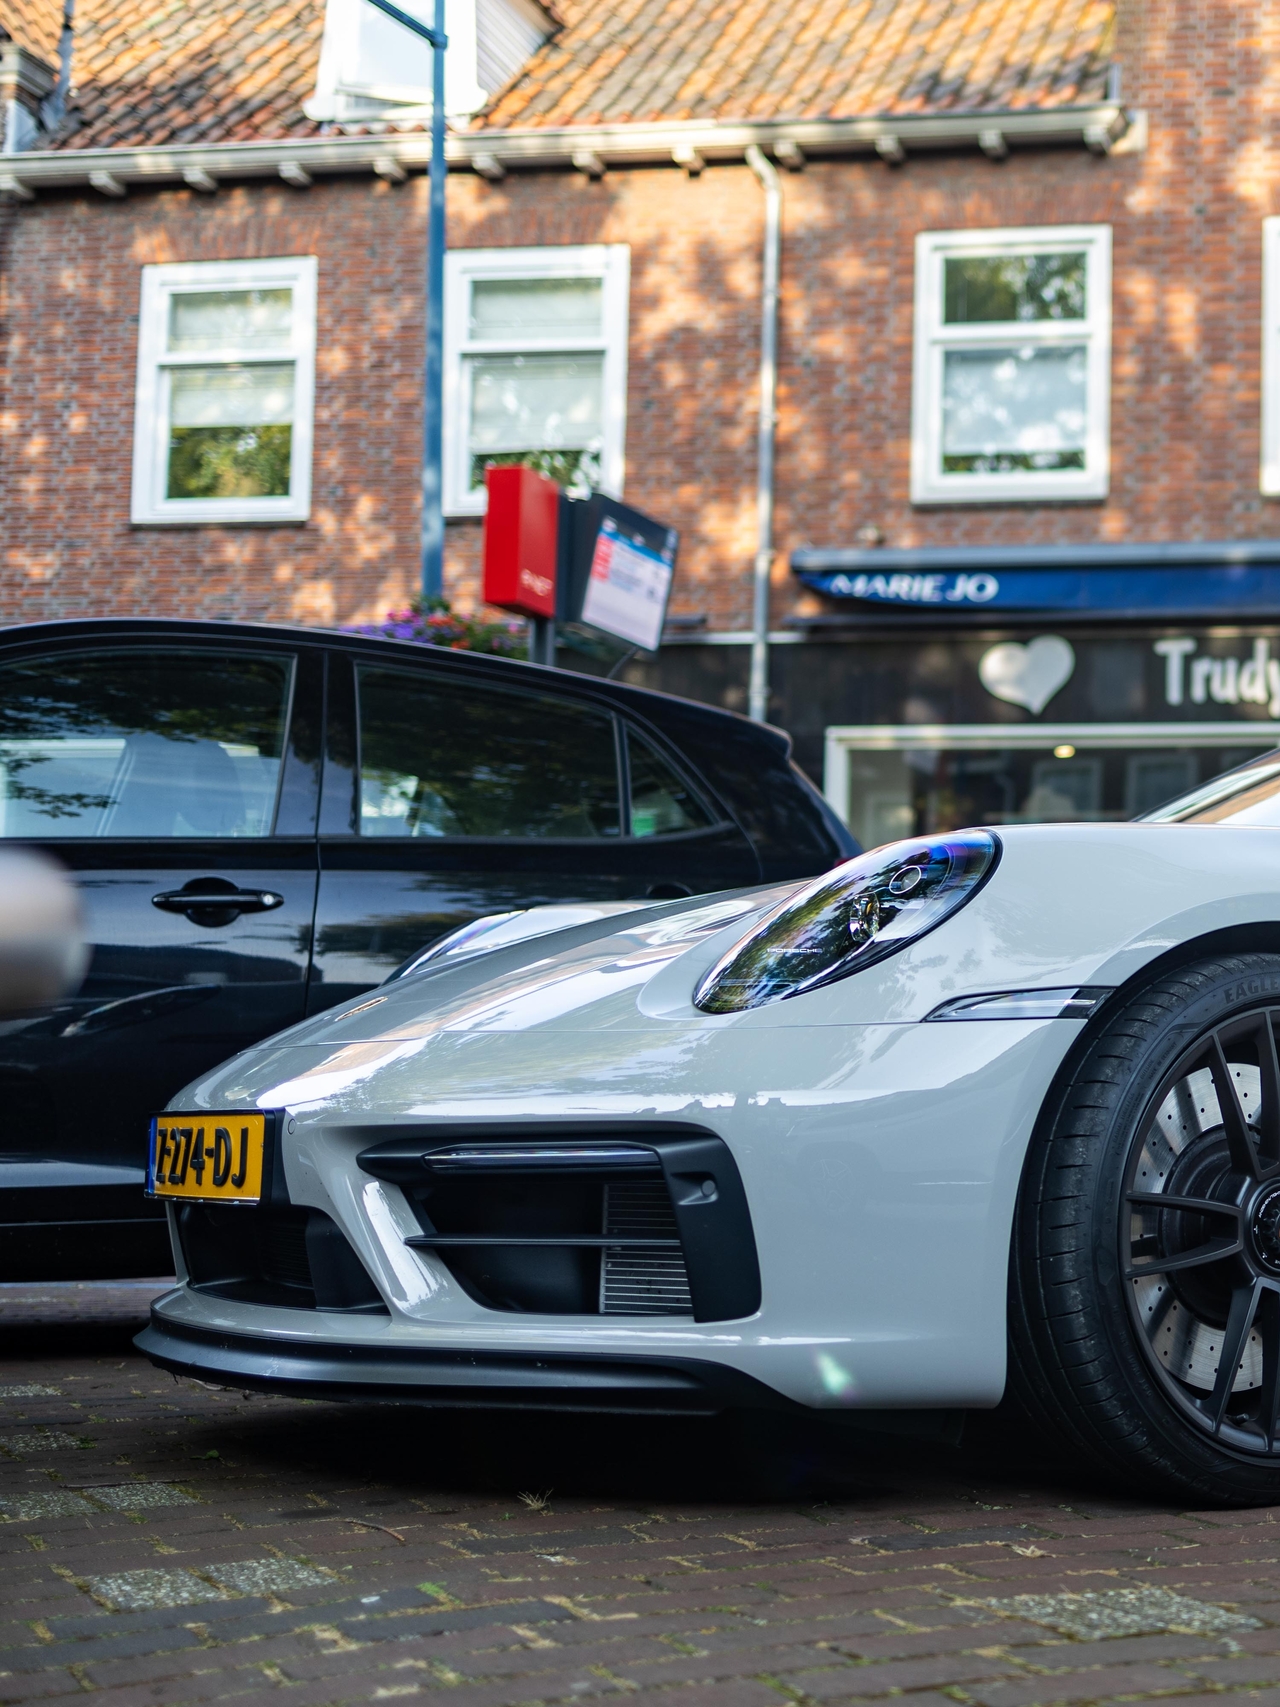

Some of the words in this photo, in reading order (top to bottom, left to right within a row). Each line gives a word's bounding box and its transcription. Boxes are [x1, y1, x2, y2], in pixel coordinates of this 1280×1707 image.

[830, 573, 946, 602] MARIE
[945, 573, 1000, 603] JO
[1223, 977, 1279, 1004] EAGLE
